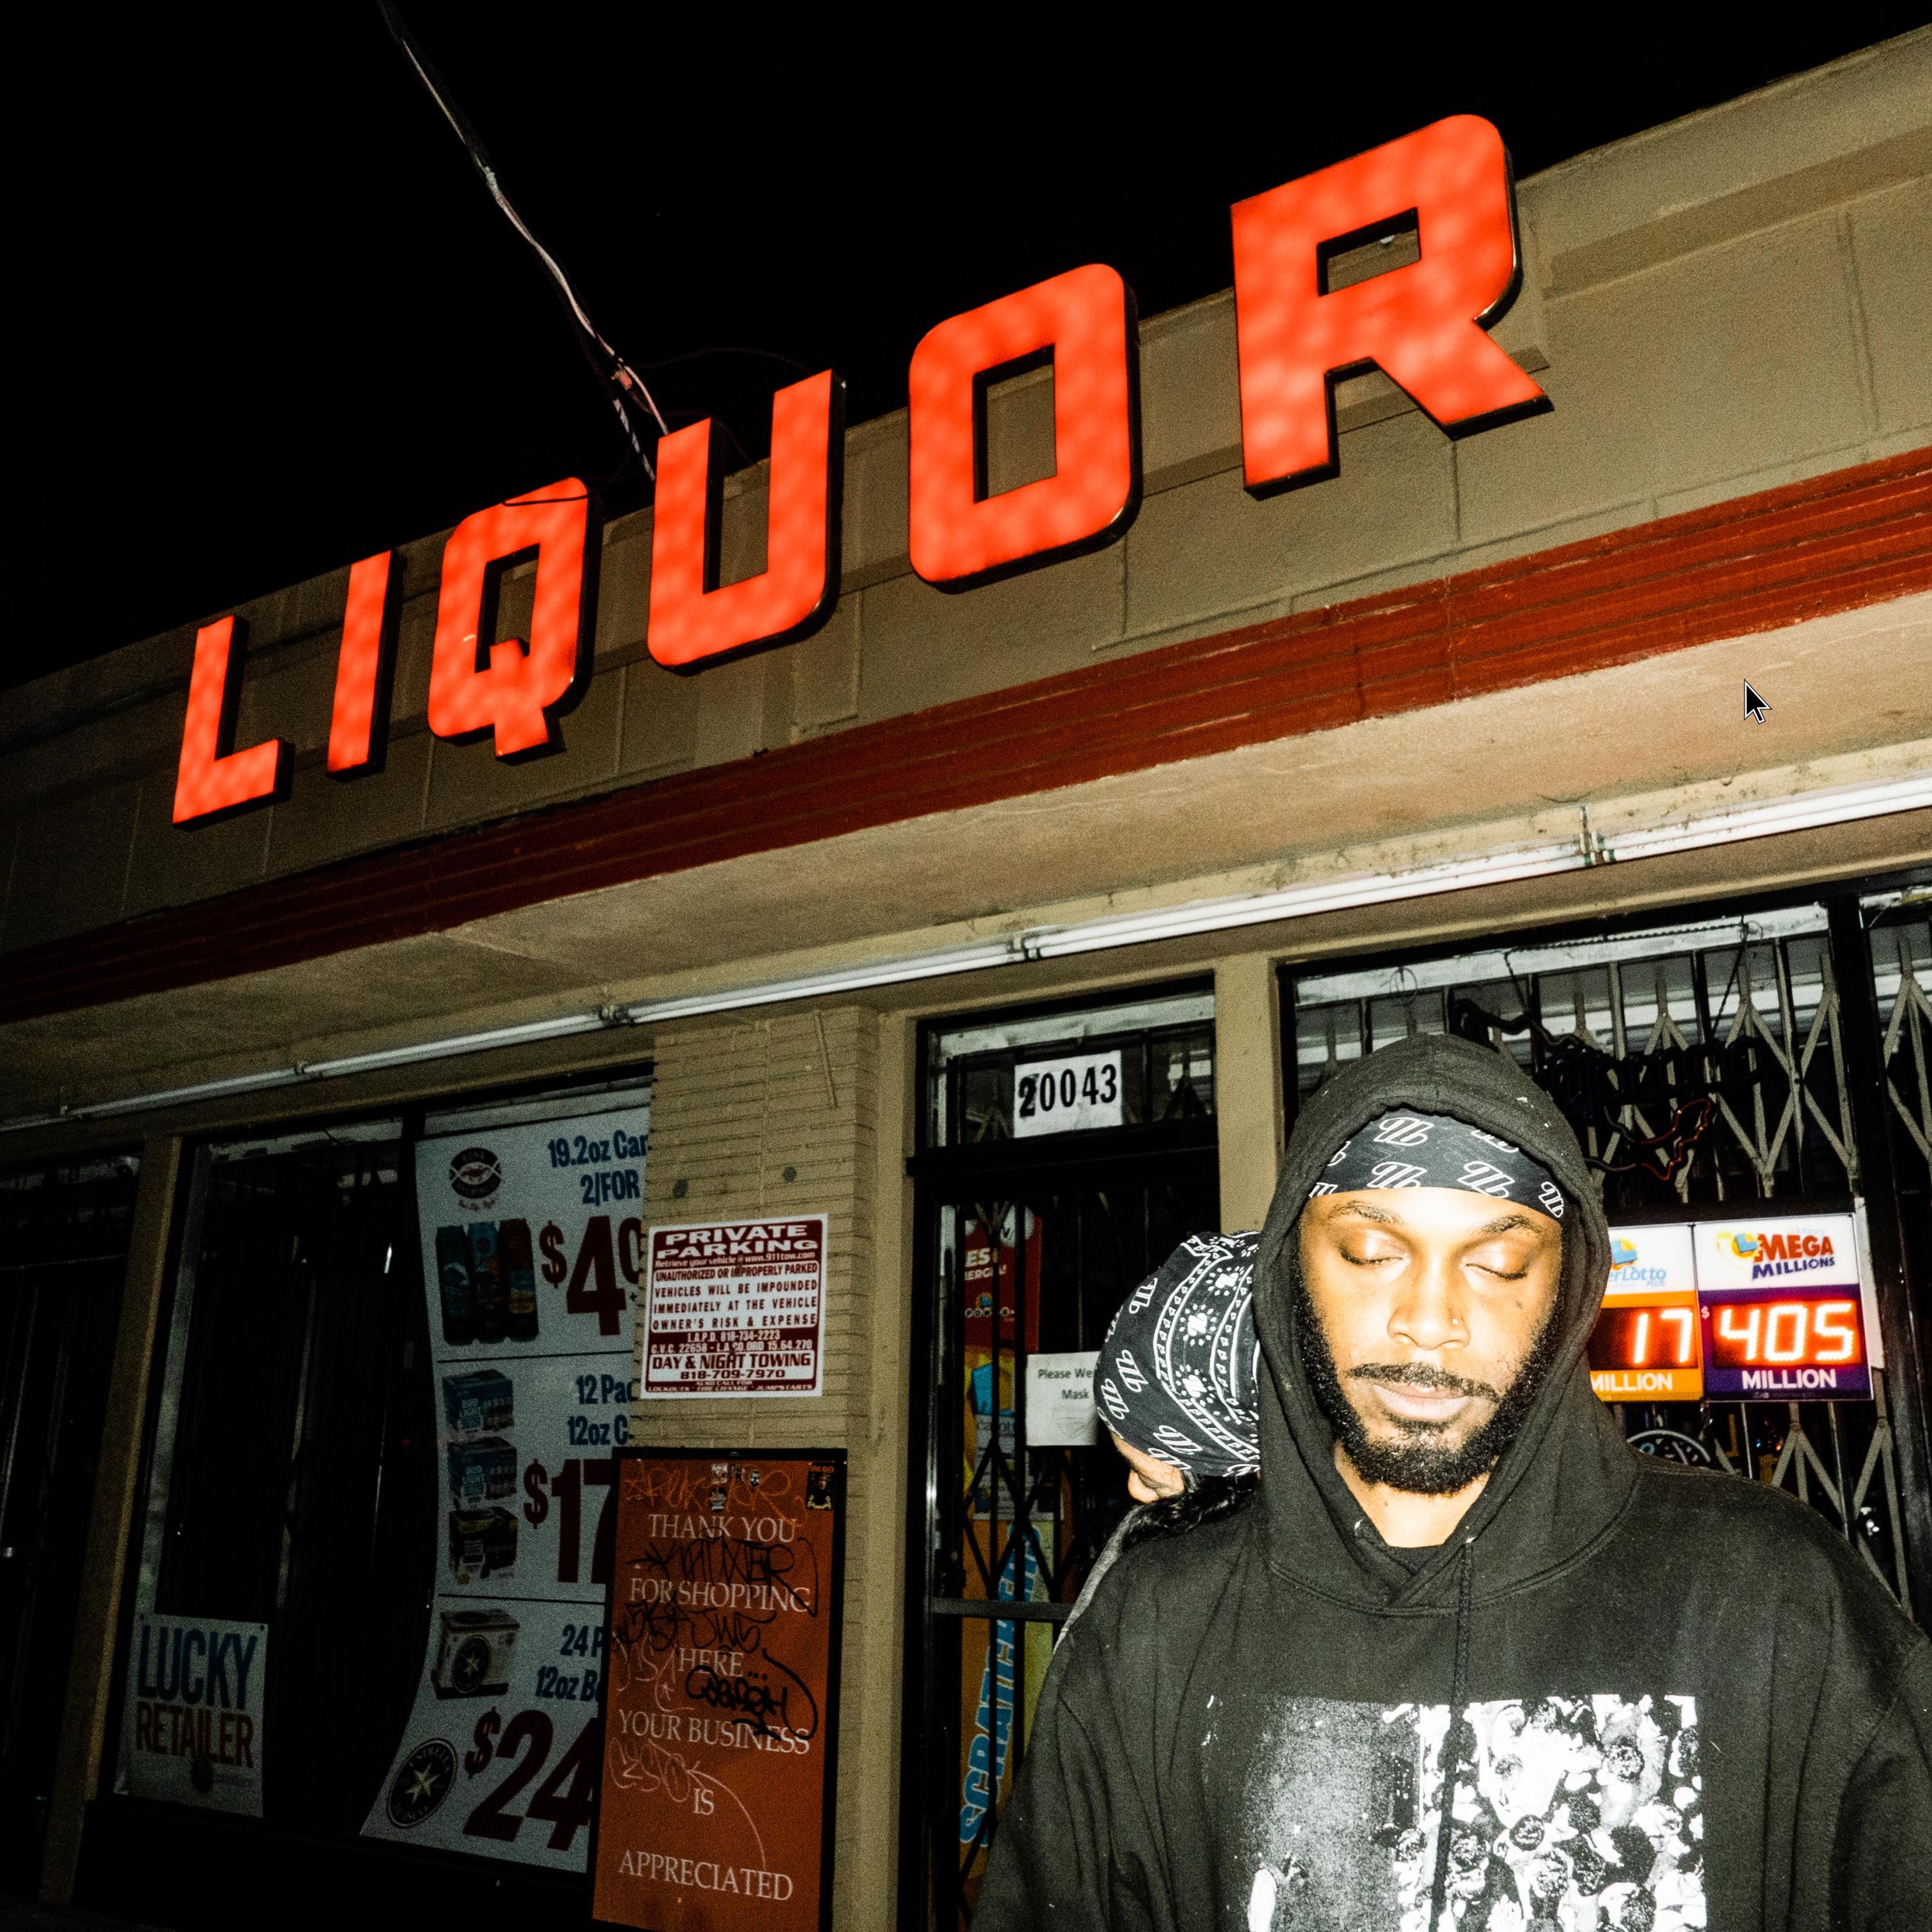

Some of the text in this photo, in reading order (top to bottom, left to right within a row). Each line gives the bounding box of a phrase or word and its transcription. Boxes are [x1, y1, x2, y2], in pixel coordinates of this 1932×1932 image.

[171, 113, 1551, 826] LIQUOR
[1019, 1064, 1117, 1117] 20043
[547, 1135, 610, 1168] 19.2oz
[580, 1168, 640, 1206] 2/FOR
[656, 1238, 819, 1260] PARKING
[665, 1224, 808, 1246] PRIVATE
[1754, 1233, 1834, 1263] MEGA
[655, 1258, 688, 1268] Retrieve
[656, 1262, 817, 1282] UNAUTHORIZED OR IMPROPERLY PARKED
[1752, 1257, 1835, 1280] MILLIONS
[655, 1279, 817, 1298] VEHICLES WILL BE IMPOUNDED
[654, 1296, 817, 1314] IMMEDIATELY AT THE VEHICLE
[652, 1314, 816, 1330] OWNER'S RISK & EXPENSE
[1632, 1308, 1693, 1365] 17
[1720, 1302, 1854, 1361] 405
[652, 1352, 810, 1369] DAY & NIGHT TOWING
[681, 1369, 786, 1379] 818-709-7970
[1037, 1368, 1072, 1379] Please
[576, 1374, 598, 1405] 12
[1061, 1388, 1090, 1400] Mask
[1742, 1369, 1837, 1390] MILLION
[567, 1414, 611, 1445] 12oz
[649, 1513, 798, 1543] THANK YOU
[630, 1577, 811, 1613] FOR SHOPPING
[560, 1624, 589, 1657] 24
[137, 1625, 258, 1710] LUCKY
[679, 1647, 744, 1678] HERE
[535, 1665, 579, 1700] 12oz
[135, 1700, 254, 1768] RETAILER
[619, 1708, 810, 1754] YOUR BUSINESS
[692, 1788, 715, 1815] IS
[618, 1850, 794, 1900] APPRECIATED
